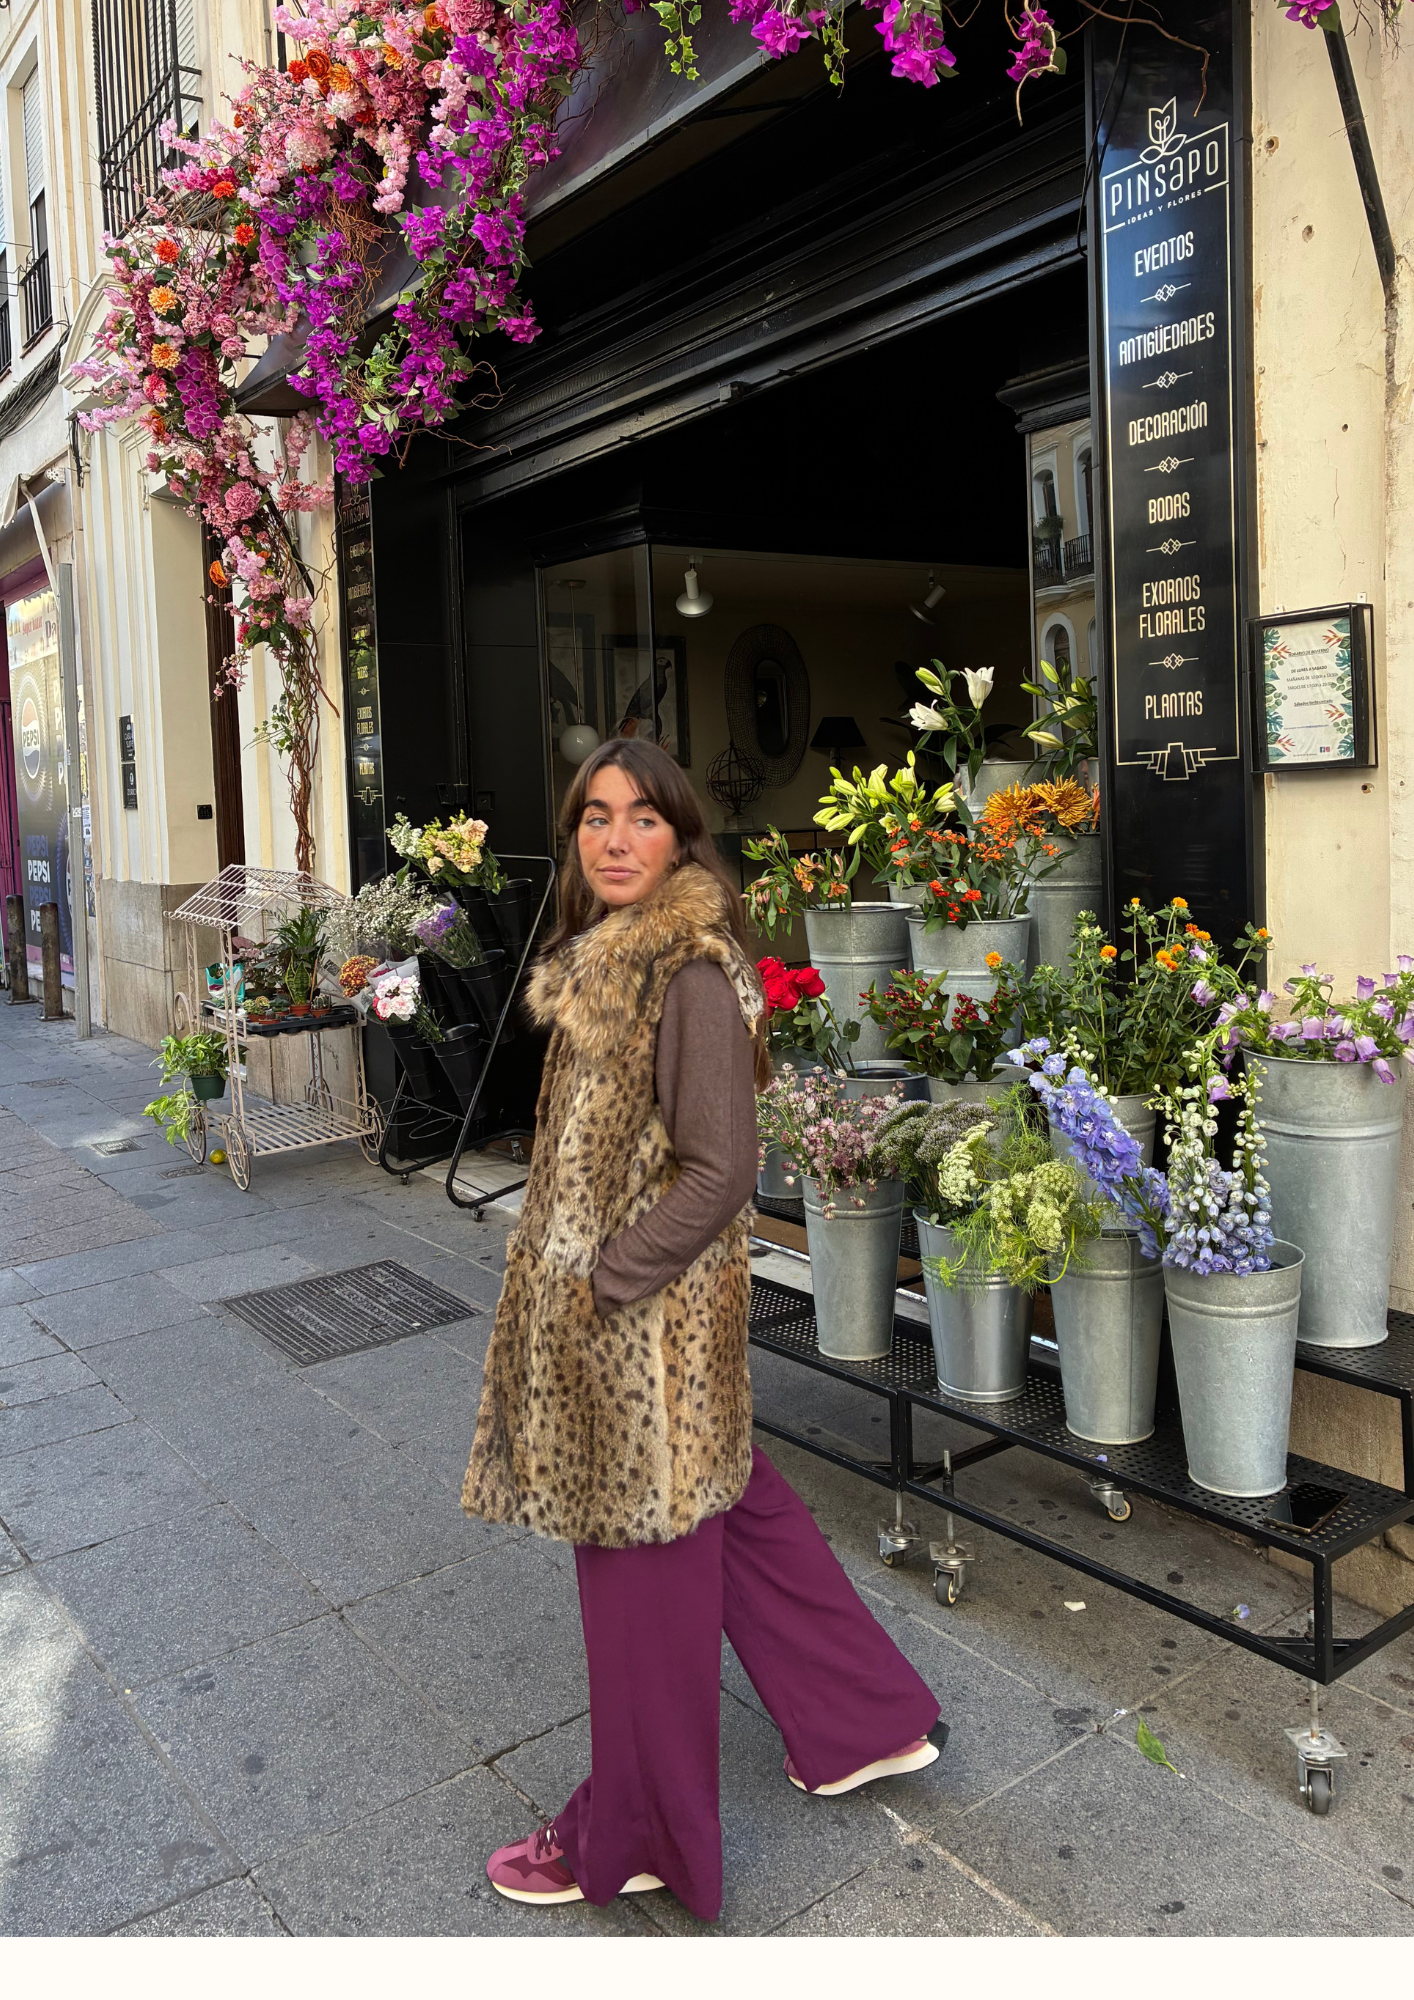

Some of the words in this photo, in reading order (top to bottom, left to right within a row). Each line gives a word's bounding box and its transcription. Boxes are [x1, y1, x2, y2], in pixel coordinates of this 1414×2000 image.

[1127, 209, 1154, 225] IDEAS
[1167, 189, 1203, 209] FLORES
[1135, 231, 1195, 277] EVENTOS
[1119, 311, 1215, 367] ANTIGÜEDADES
[1129, 400, 1208, 446] DECORACIÓN
[1148, 491, 1191, 525] BODAS
[1142, 574, 1201, 608] EXORNOS
[1139, 606, 1206, 639] FLORALES
[1145, 690, 1203, 721] PLANTAS
[22, 729, 40, 748] PEPSI
[26, 835, 49, 858] PEPSI
[28, 860, 51, 883] PEPSI
